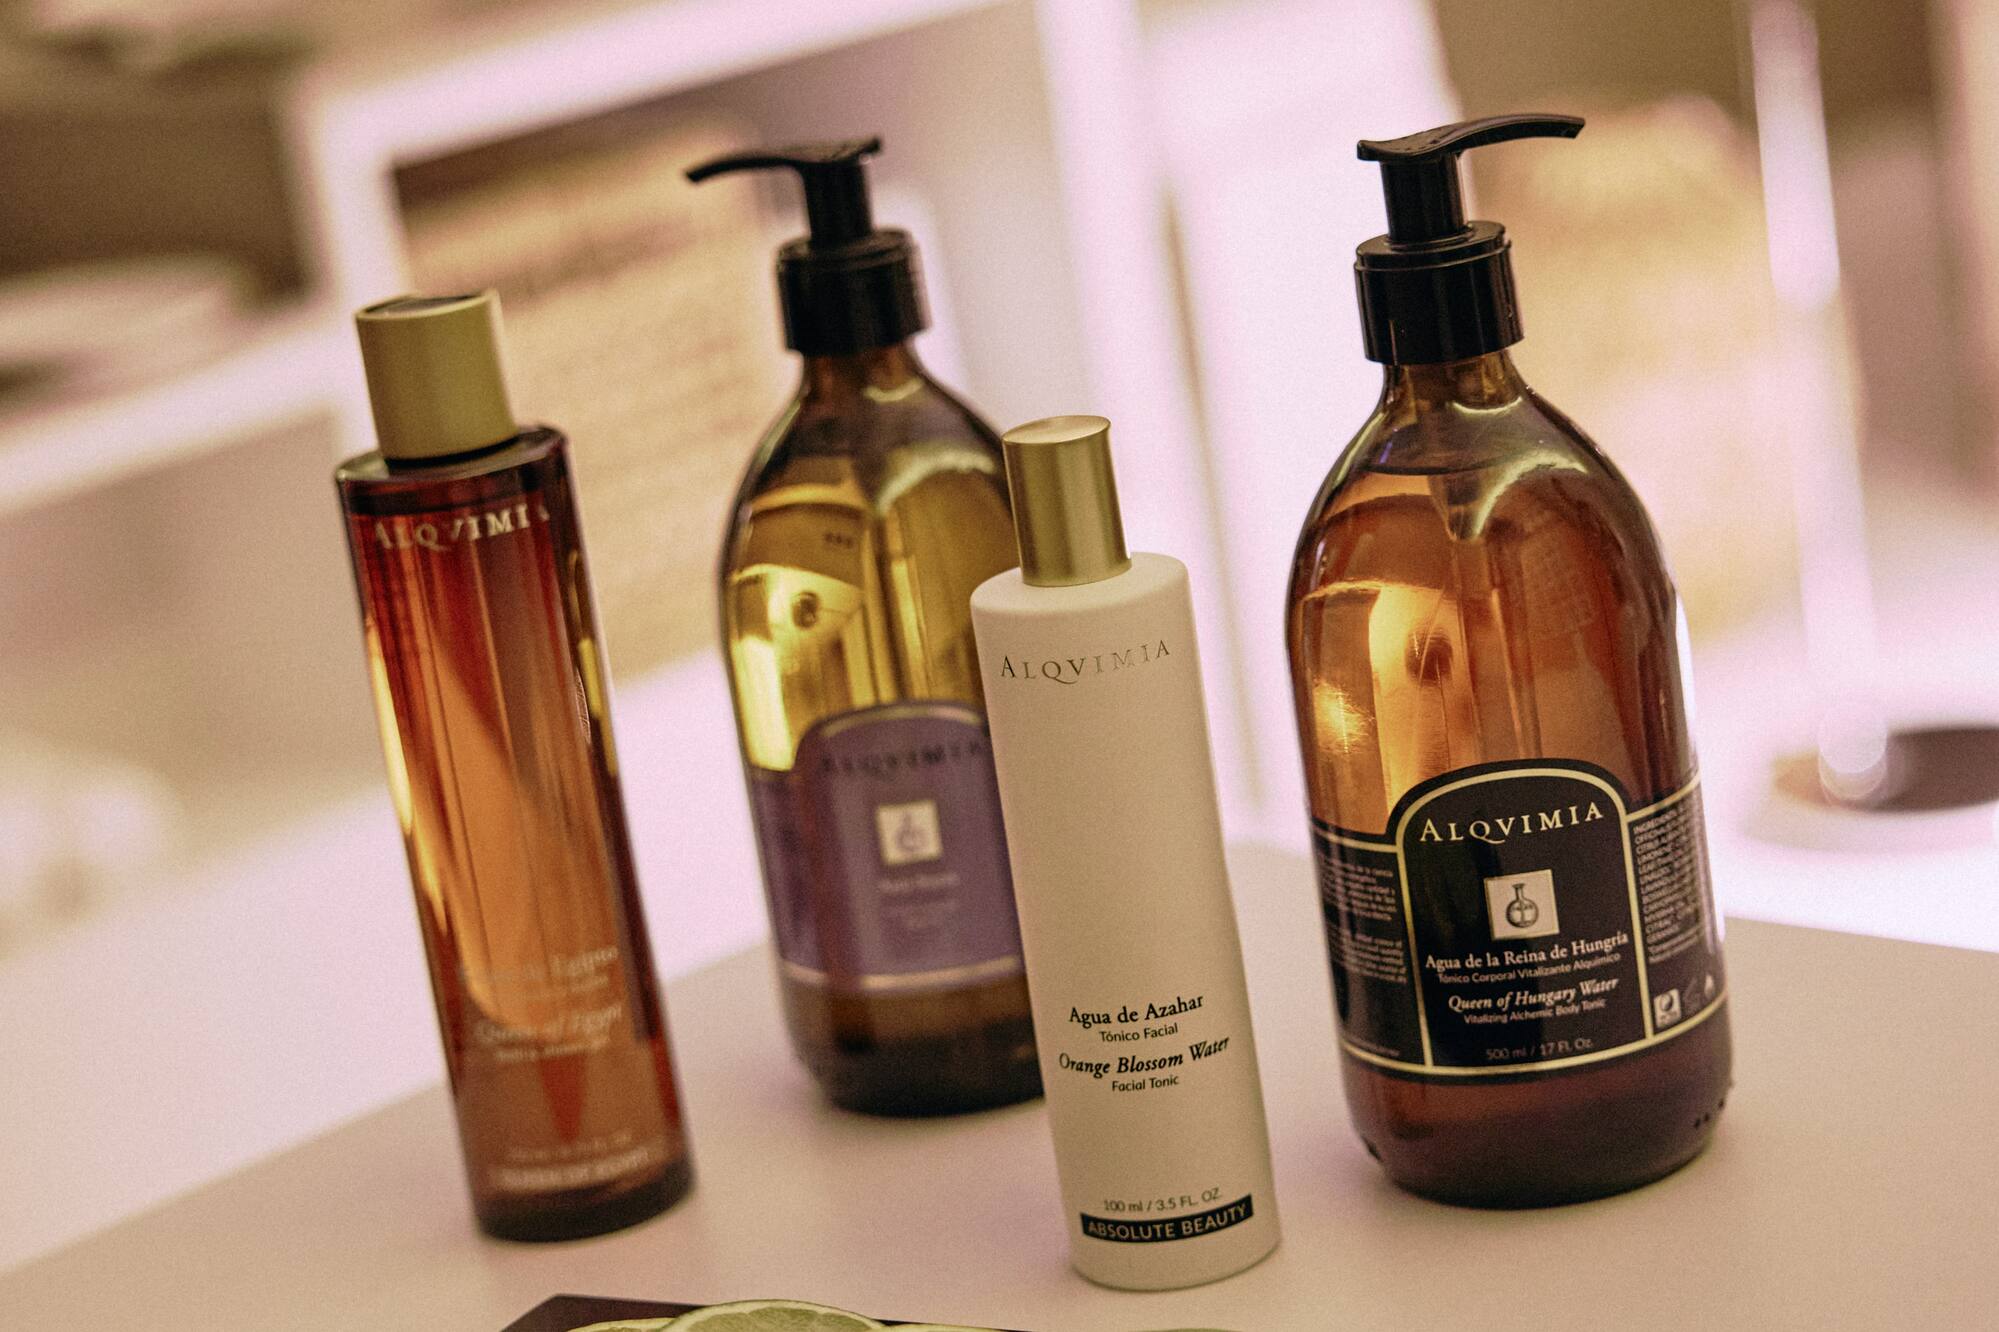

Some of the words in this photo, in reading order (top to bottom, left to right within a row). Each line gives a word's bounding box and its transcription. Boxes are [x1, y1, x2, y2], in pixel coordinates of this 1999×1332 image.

[1000, 639, 1170, 684] ALQVIMIA
[1420, 802, 1604, 845] ALQVIMIA
[1426, 954, 1461, 973] Agua
[1465, 954, 1482, 969] de
[1486, 952, 1500, 967] la
[1504, 950, 1546, 965] Reina
[1550, 943, 1568, 959] de
[1472, 970, 1516, 984] Corporal
[1448, 995, 1493, 1013] Queen
[1496, 991, 1514, 1010] of
[1514, 986, 1576, 1006] Hungary
[1579, 976, 1619, 996] Water
[1556, 1003, 1580, 1016] Body
[1069, 1006, 1112, 1029] Agua
[1117, 1005, 1139, 1024] de
[1144, 995, 1203, 1021] Azahar
[1099, 1030, 1140, 1043] Tónico
[1144, 1023, 1179, 1039] Facial
[1059, 1052, 1111, 1079] Orange
[1116, 1054, 1184, 1074] Blossom
[1189, 1037, 1230, 1062] Water
[1486, 1047, 1510, 1061] 500
[1540, 1042, 1555, 1057] 17
[1112, 1079, 1146, 1092] Facial
[1149, 1074, 1179, 1089] Tonic
[1104, 1199, 1126, 1212] 100
[1128, 1199, 1144, 1212] ml
[1156, 1197, 1178, 1212] 3.5
[1088, 1221, 1176, 1240] ABSOLUTE
[1181, 1203, 1247, 1237] BEAUTY
